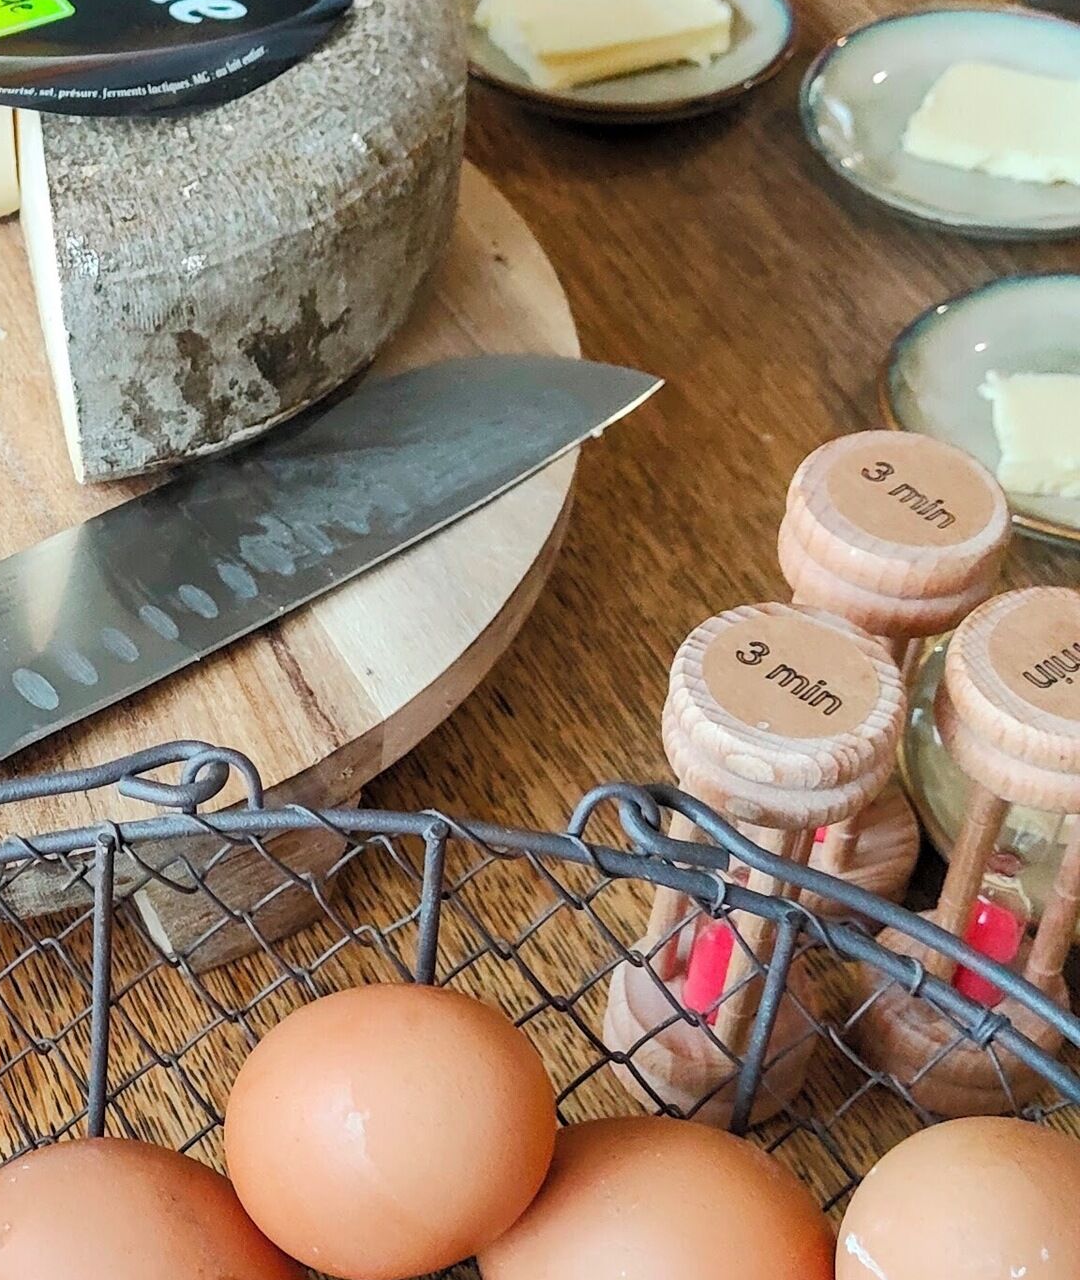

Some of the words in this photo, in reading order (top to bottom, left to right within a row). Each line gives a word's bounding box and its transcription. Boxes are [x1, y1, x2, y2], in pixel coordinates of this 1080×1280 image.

[102, 86, 147, 100] ferments
[191, 70, 211, 86] MG
[860, 460, 895, 483] 3
[887, 480, 957, 530] min
[735, 641, 771, 667] 3
[765, 659, 844, 717] min
